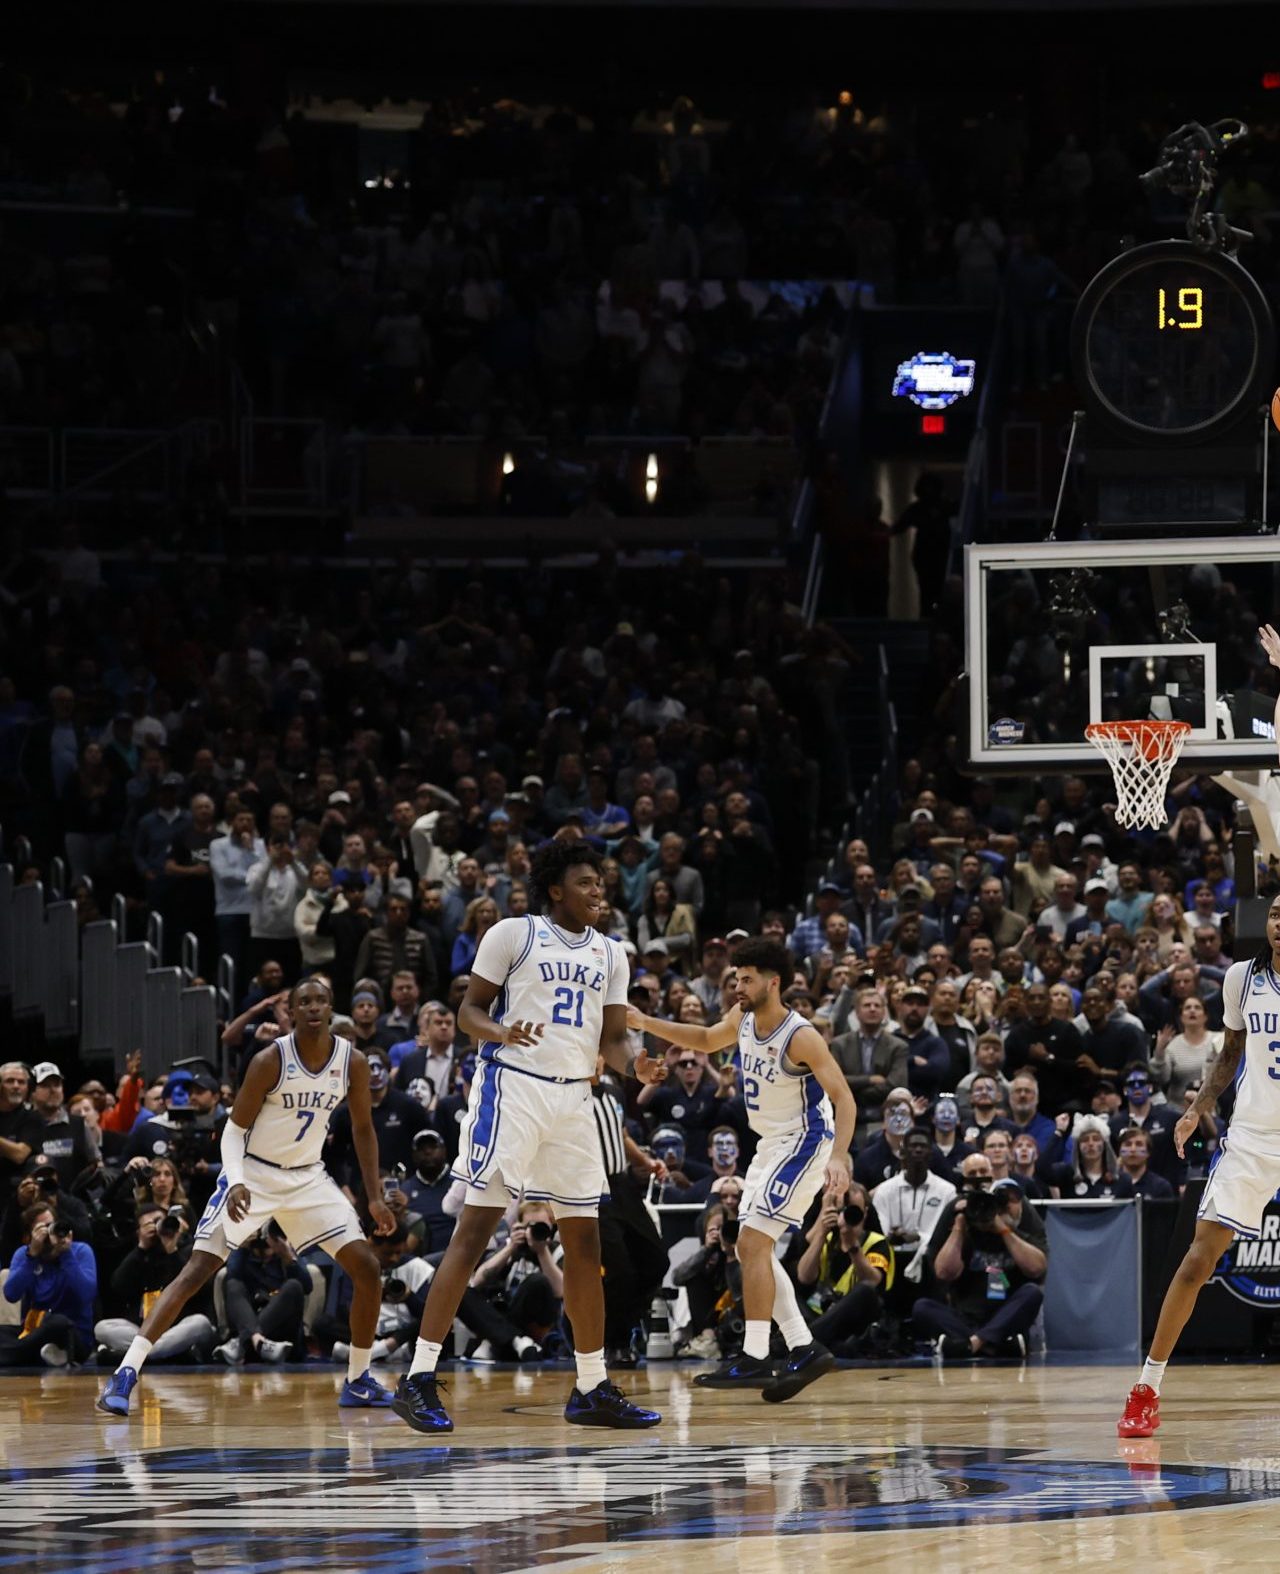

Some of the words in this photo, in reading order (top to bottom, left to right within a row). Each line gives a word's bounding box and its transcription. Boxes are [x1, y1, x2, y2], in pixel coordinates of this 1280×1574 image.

[1159, 288, 1202, 329] 1.9
[538, 961, 605, 992] DUKE
[552, 987, 585, 1028] 21
[281, 1091, 339, 1111] DUKE
[294, 1110, 316, 1142] 7
[1253, 1286, 1280, 1297] ELITE
